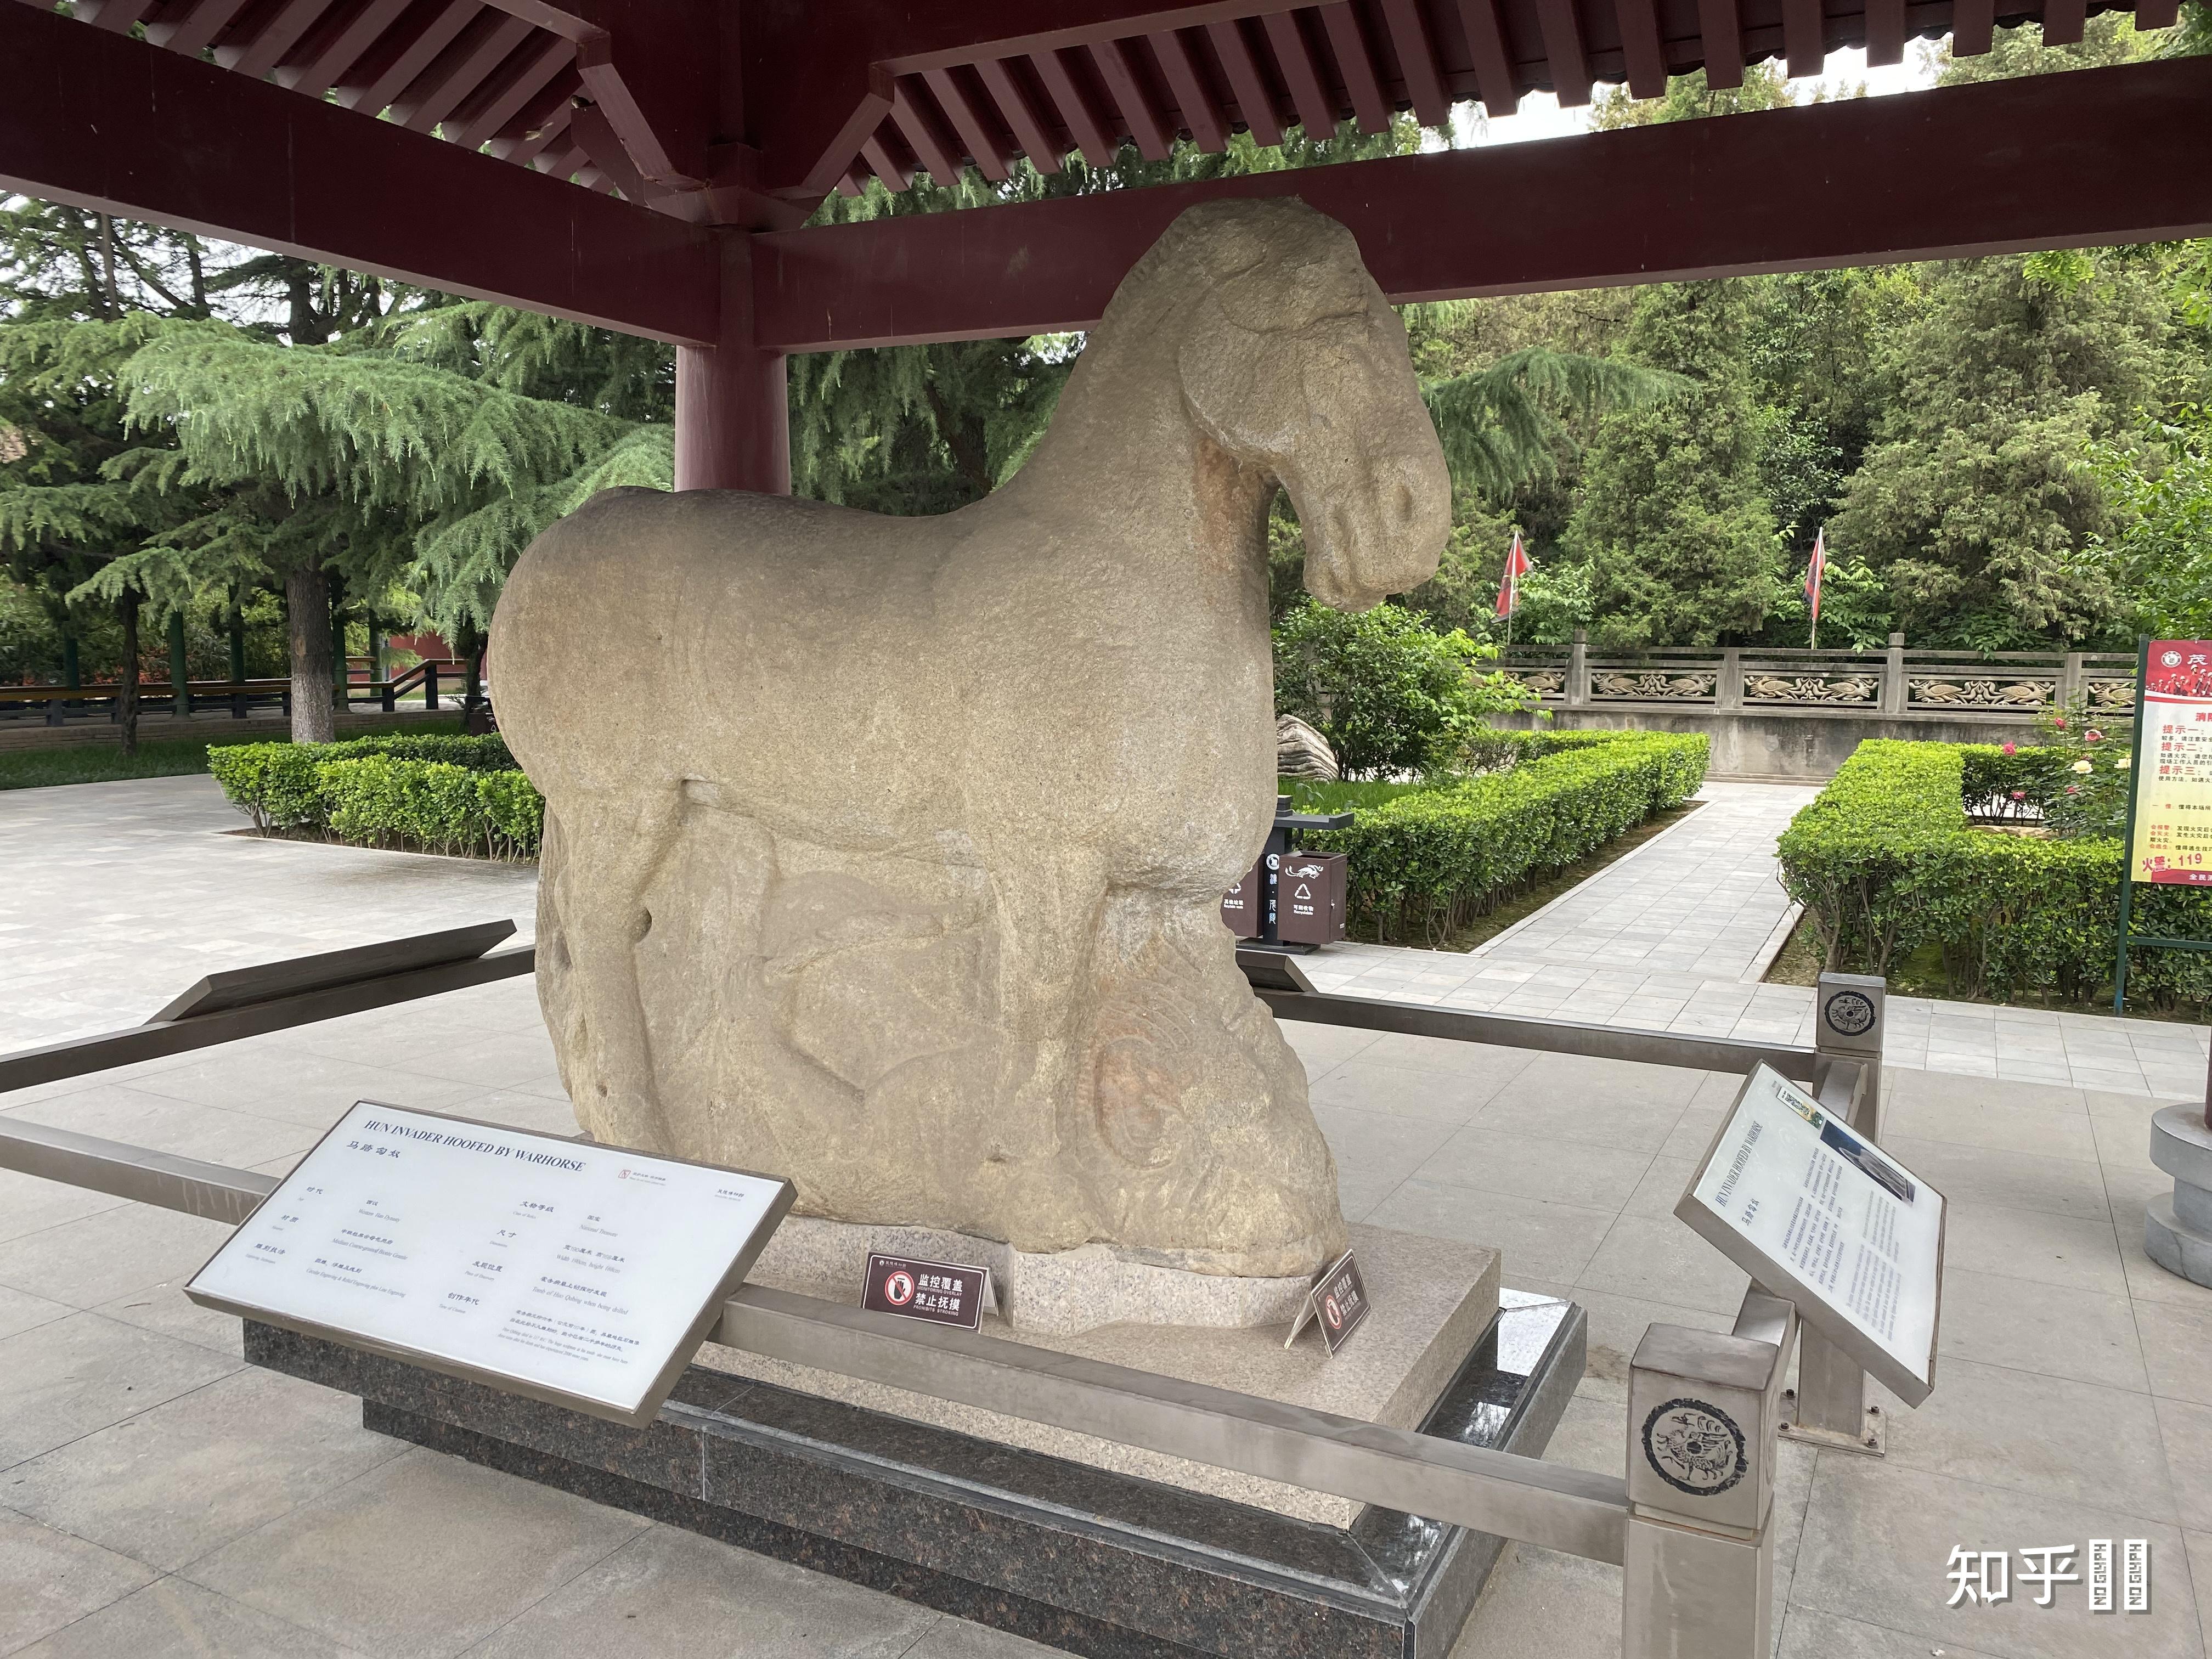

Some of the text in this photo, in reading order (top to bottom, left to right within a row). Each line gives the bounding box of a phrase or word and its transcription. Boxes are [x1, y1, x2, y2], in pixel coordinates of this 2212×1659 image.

[2187, 654, 2212, 665] 茂
[2163, 725, 2204, 735] 提示一：
[2161, 742, 2203, 752] 提示二：
[2159, 765, 2200, 775] 提示三：
[2142, 853, 2202, 872] 火警： 119
[346, 1141, 402, 1158] 马踏匈奴
[363, 1120, 586, 1171] HUN INVADER HOOFED BY WARHORSE
[1715, 1120, 1763, 1207] HUN INVADER HOOFED BY WARHORSE
[520, 1201, 555, 1212] 文物等级
[1742, 1198, 1760, 1226] 马踏匈奴
[281, 1215, 299, 1223] 材质
[496, 1229, 518, 1238] 尺寸
[472, 1260, 505, 1272] 发现位置
[918, 1273, 962, 1292] 监控覆盖
[917, 1285, 943, 1294] MONITORING
[448, 1293, 479, 1305] 创作年代
[915, 1292, 960, 1312] 禁止抚摸
[597, 1303, 611, 1312] being
[612, 1307, 629, 1315] drilled
[913, 1305, 959, 1317] PROHIBITS STROKING
